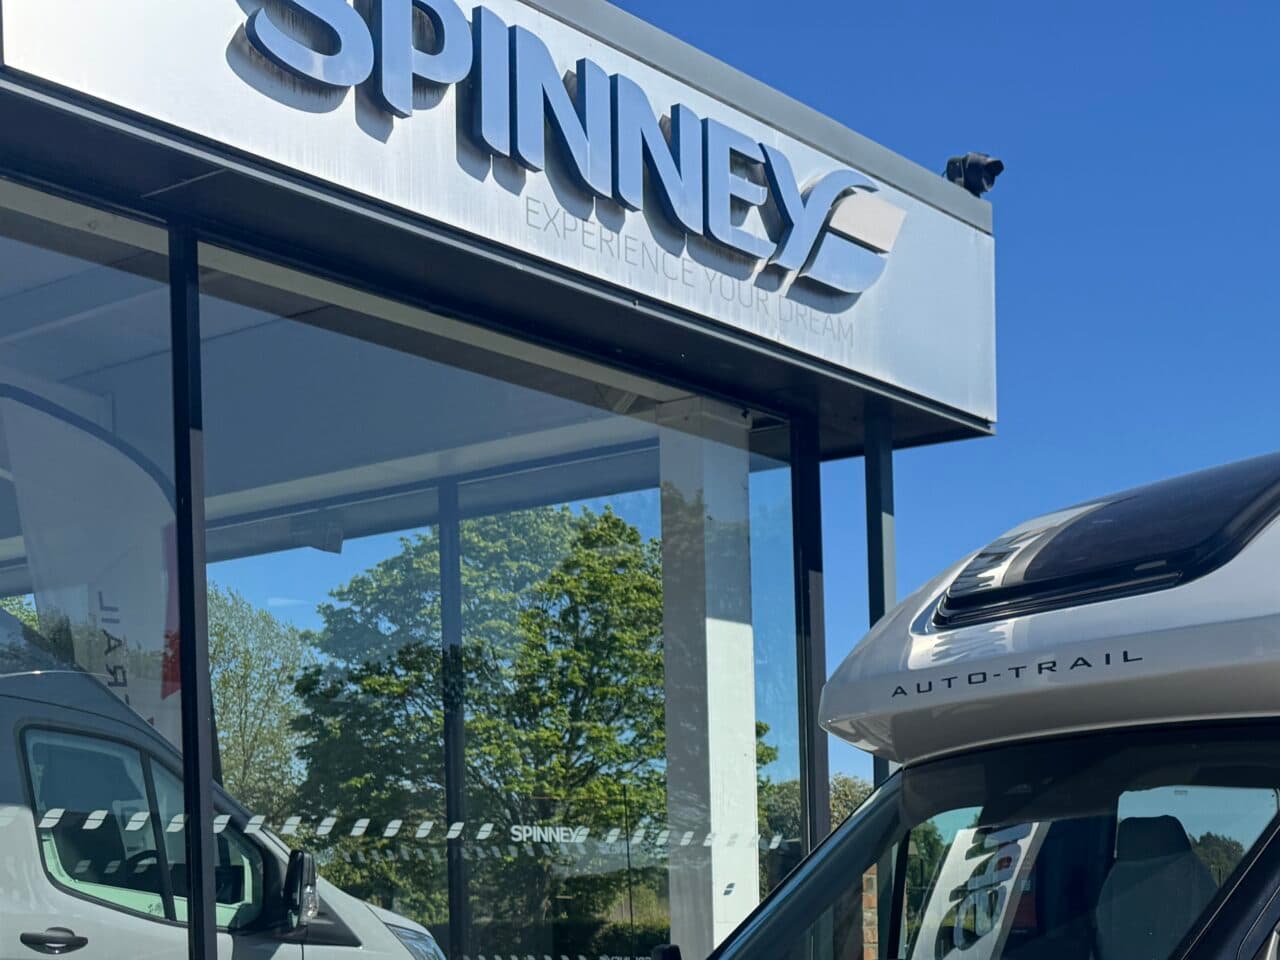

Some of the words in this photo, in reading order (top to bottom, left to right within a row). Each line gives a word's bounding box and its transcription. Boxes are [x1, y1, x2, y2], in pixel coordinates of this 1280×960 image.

[246, 0, 882, 275] SPINNEY
[525, 196, 696, 288] EXPERIENCE
[705, 269, 770, 316] YOUR
[779, 294, 855, 347] DREAM
[891, 650, 1143, 698] AUTO-TRAIL
[510, 825, 584, 843] SPINNEY
